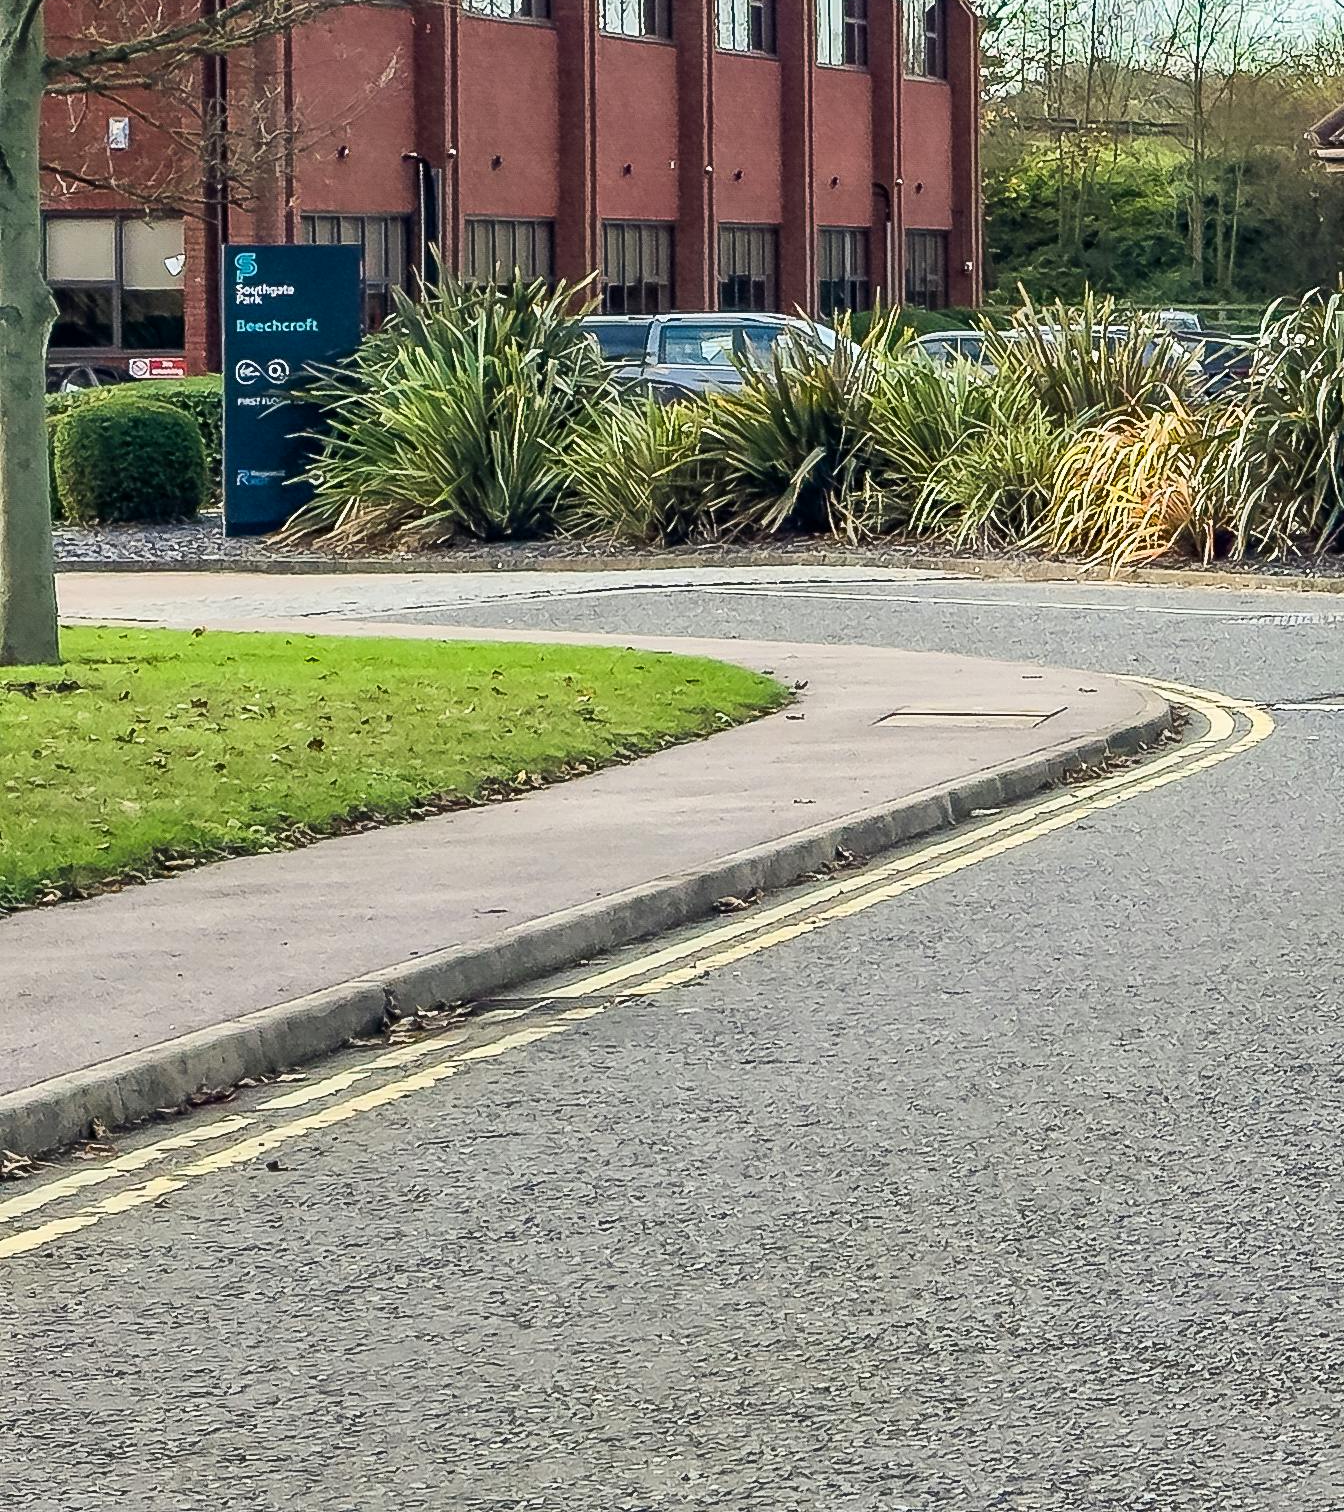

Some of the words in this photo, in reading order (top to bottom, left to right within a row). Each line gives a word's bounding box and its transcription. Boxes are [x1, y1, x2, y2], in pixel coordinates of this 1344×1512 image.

[236, 284, 295, 297] Southgate
[236, 295, 263, 304] Park
[236, 319, 318, 332] Beechcroft
